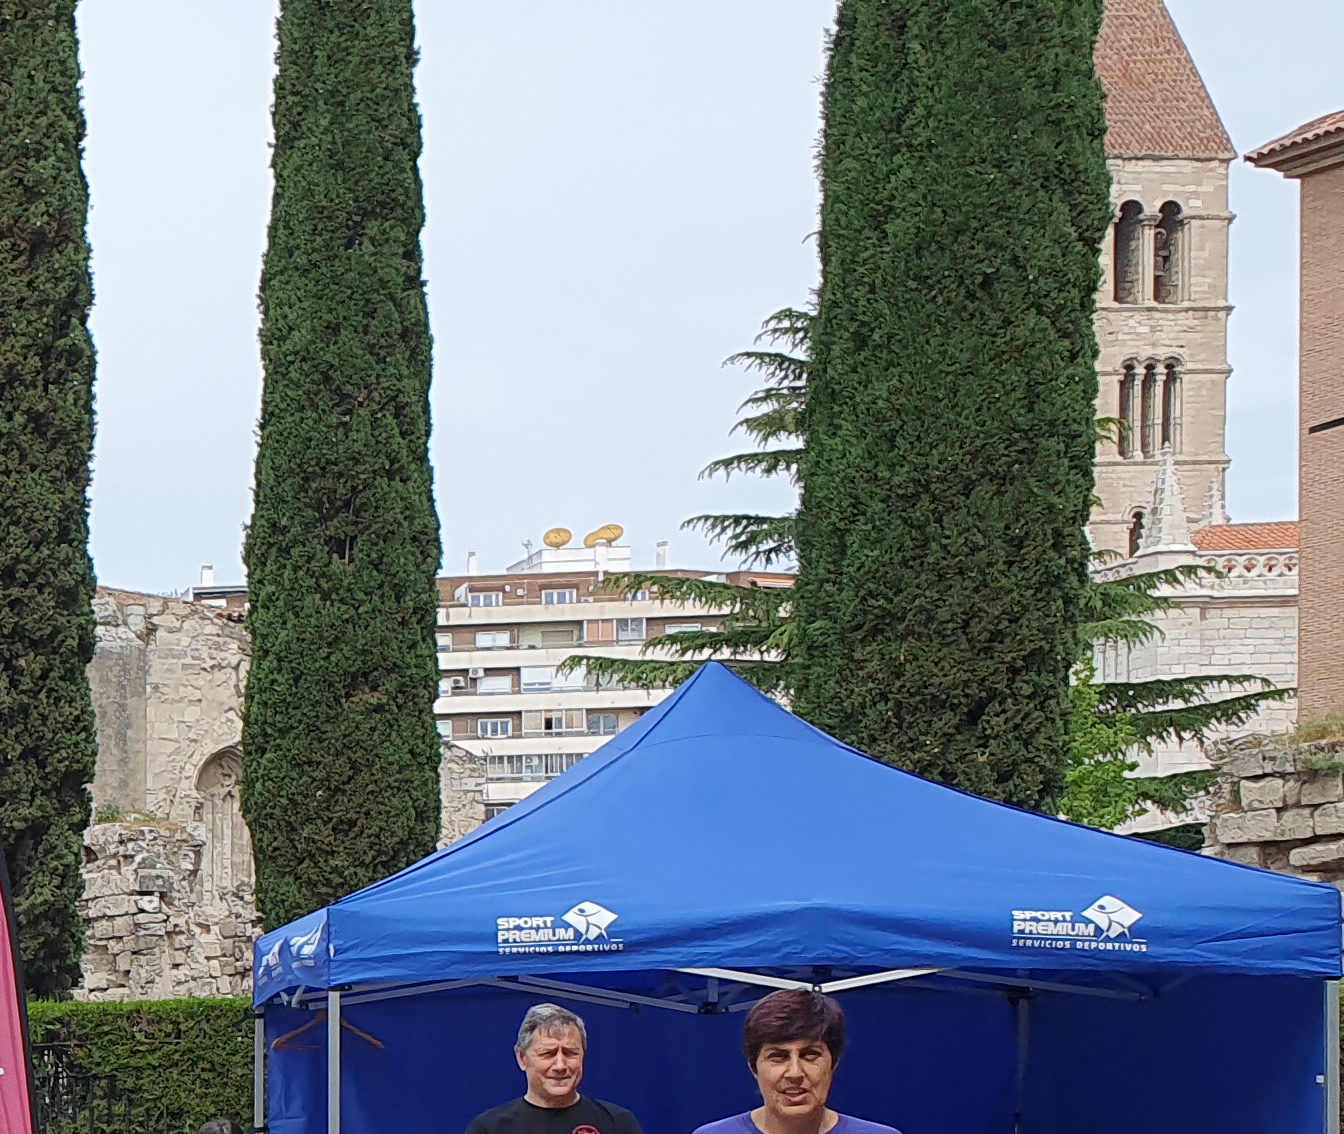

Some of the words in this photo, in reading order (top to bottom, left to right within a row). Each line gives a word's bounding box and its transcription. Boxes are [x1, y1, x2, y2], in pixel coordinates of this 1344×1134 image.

[496, 916, 555, 929] SPORT
[1011, 910, 1074, 921] SPORT
[497, 927, 575, 943] PREMIUM
[1012, 921, 1096, 936] PREMIUM
[1011, 938, 1071, 949] SERVICIOS
[1076, 941, 1148, 952] DEPORTIVOS
